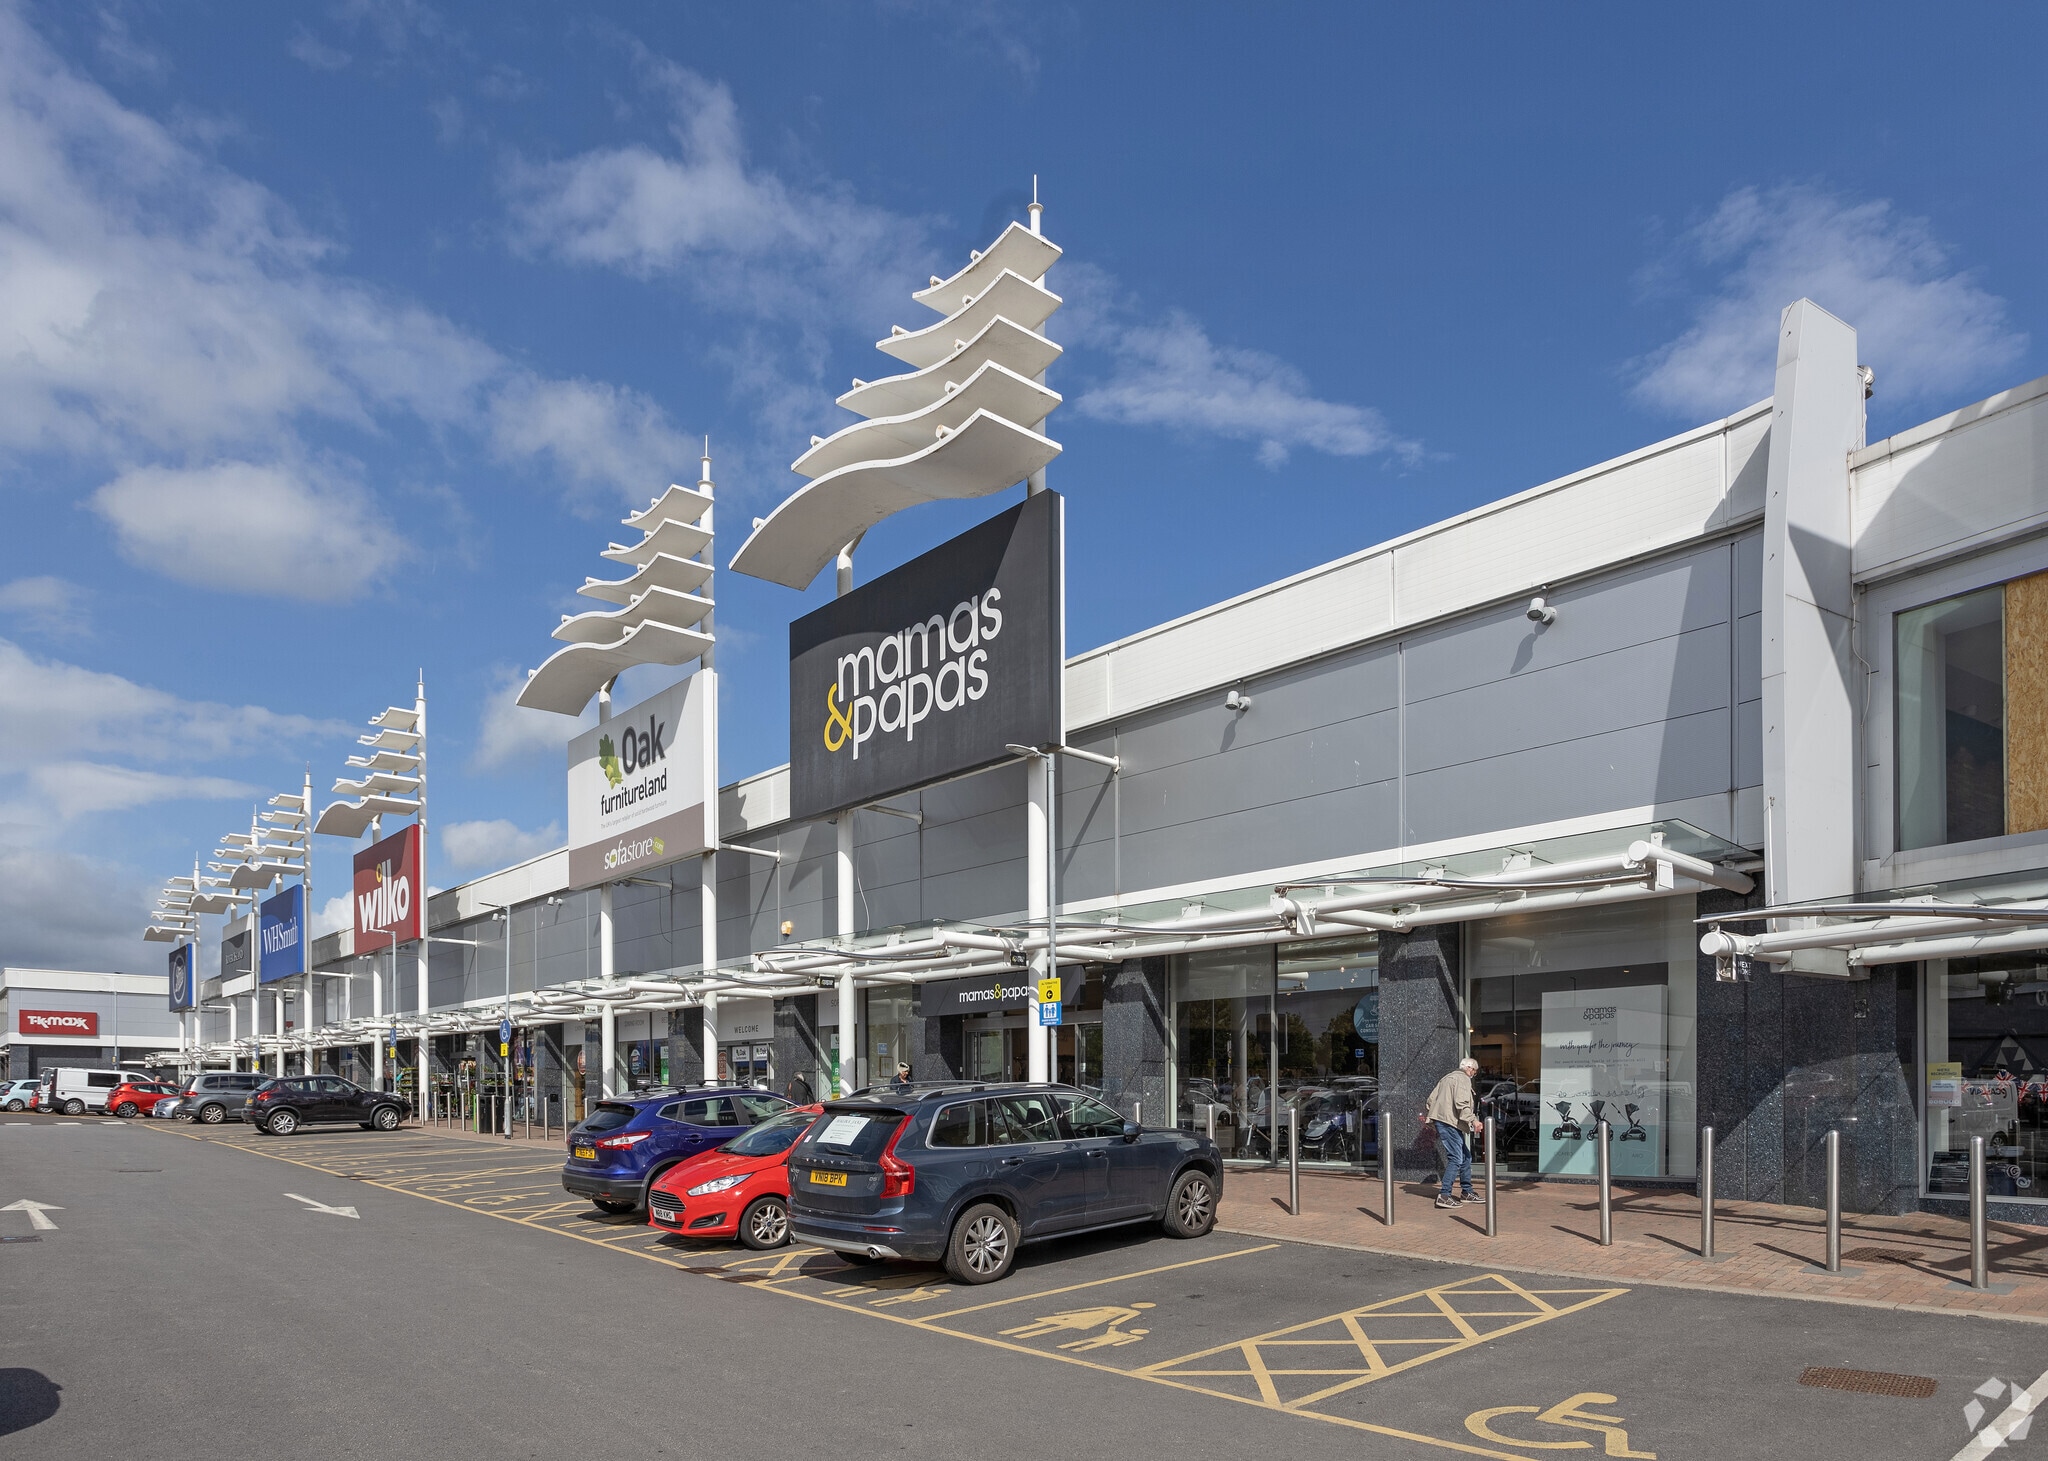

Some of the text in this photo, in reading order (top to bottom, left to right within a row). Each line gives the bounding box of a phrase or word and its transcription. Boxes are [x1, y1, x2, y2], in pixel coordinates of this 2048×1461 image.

[838, 587, 1003, 702] mamas
[621, 713, 666, 776] Oak
[600, 767, 667, 816] furnitureland
[604, 836, 653, 871] sofastore
[358, 859, 410, 933] wilko
[262, 917, 298, 955] WHSmith
[1585, 1006, 1617, 1014] mamas
[734, 1024, 759, 1034] WELCOME
[1598, 1039, 1610, 1050] the
[829, 1174, 843, 1184] BPK
